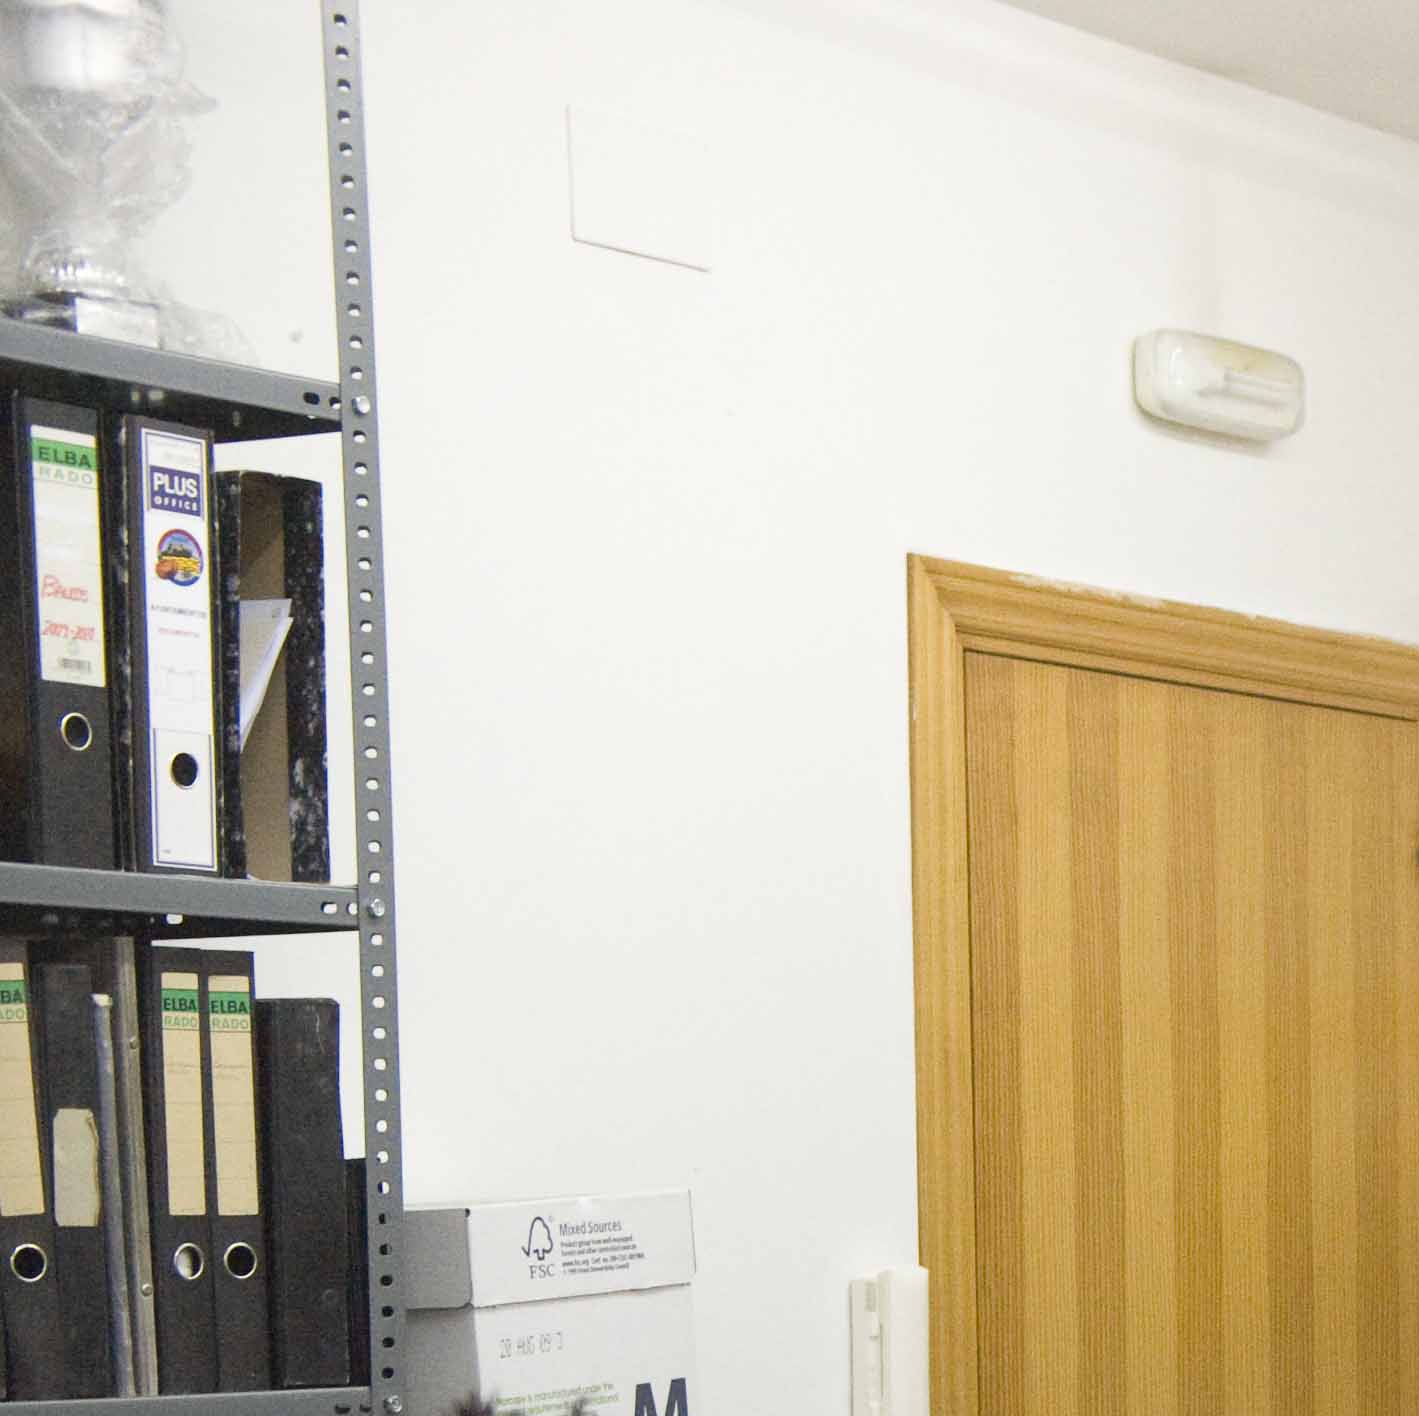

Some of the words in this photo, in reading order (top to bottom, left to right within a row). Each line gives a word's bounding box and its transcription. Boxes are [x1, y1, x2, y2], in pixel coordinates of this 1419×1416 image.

[38, 446, 92, 469] ELBA
[153, 472, 199, 498] PLUS
[153, 495, 198, 512] OFFICE
[0, 989, 23, 1004] BA
[163, 997, 197, 1013] ELBA
[211, 999, 249, 1015] ELBA
[0, 1009, 25, 1021] ADO
[164, 1015, 198, 1029] RADO
[211, 1017, 249, 1030] RADO
[560, 1221, 586, 1237] Mixed
[588, 1219, 623, 1235] Sources
[529, 1263, 556, 1280] FSC
